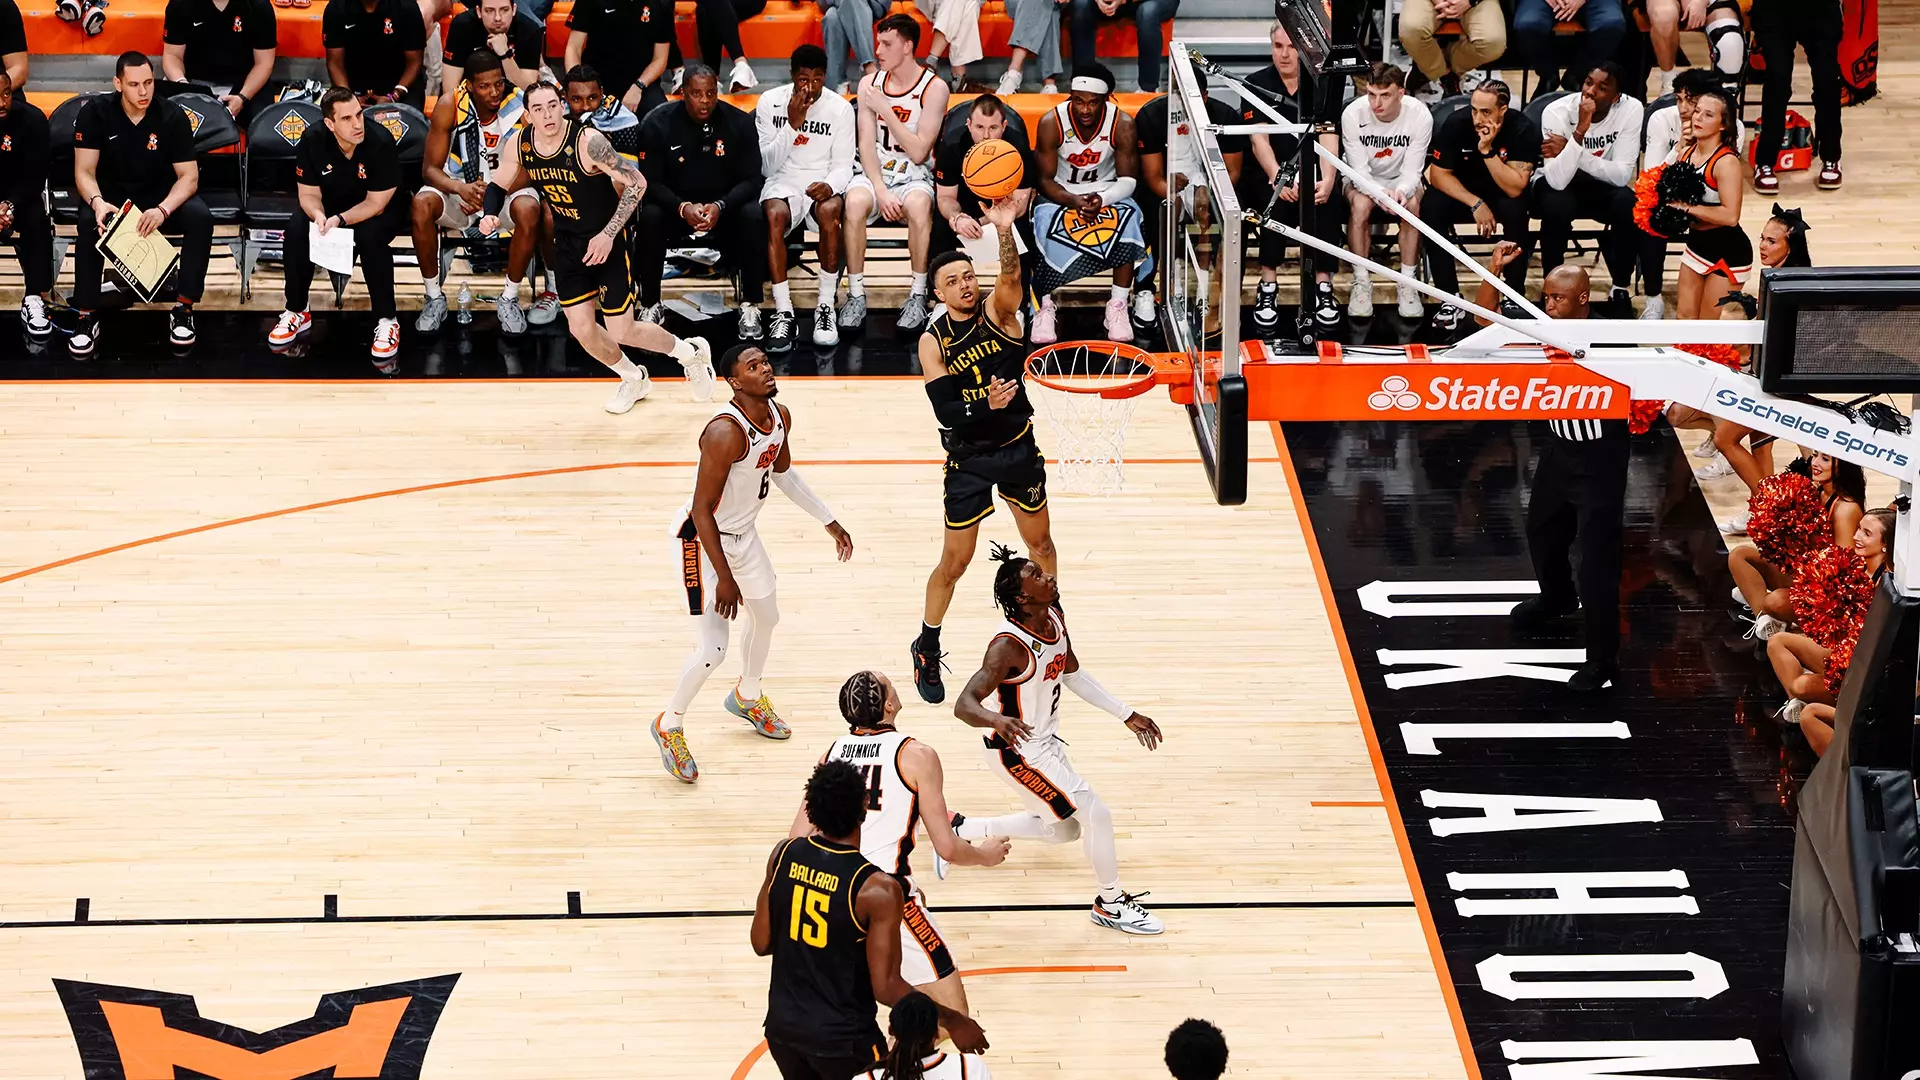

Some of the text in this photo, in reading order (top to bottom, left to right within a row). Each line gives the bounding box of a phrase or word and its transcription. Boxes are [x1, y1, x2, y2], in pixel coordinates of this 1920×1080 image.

[809, 121, 831, 136] EASY.
[1359, 135, 1393, 148] NOTHING
[1780, 153, 1794, 169] G
[527, 167, 578, 183] WICHITA
[1067, 164, 1097, 184] 14
[543, 184, 573, 204] 55
[971, 365, 982, 385] 1
[1737, 396, 1909, 467] Schelde Sports
[758, 469, 769, 500] 6
[684, 541, 699, 588] OWBOYS
[1050, 683, 1061, 716] 2
[840, 743, 882, 759] SUEMNICK
[1010, 764, 1058, 801] COWBOYS
[788, 861, 840, 893] BALLARD
[789, 884, 831, 948] 15
[903, 901, 941, 952] COWBOYS
